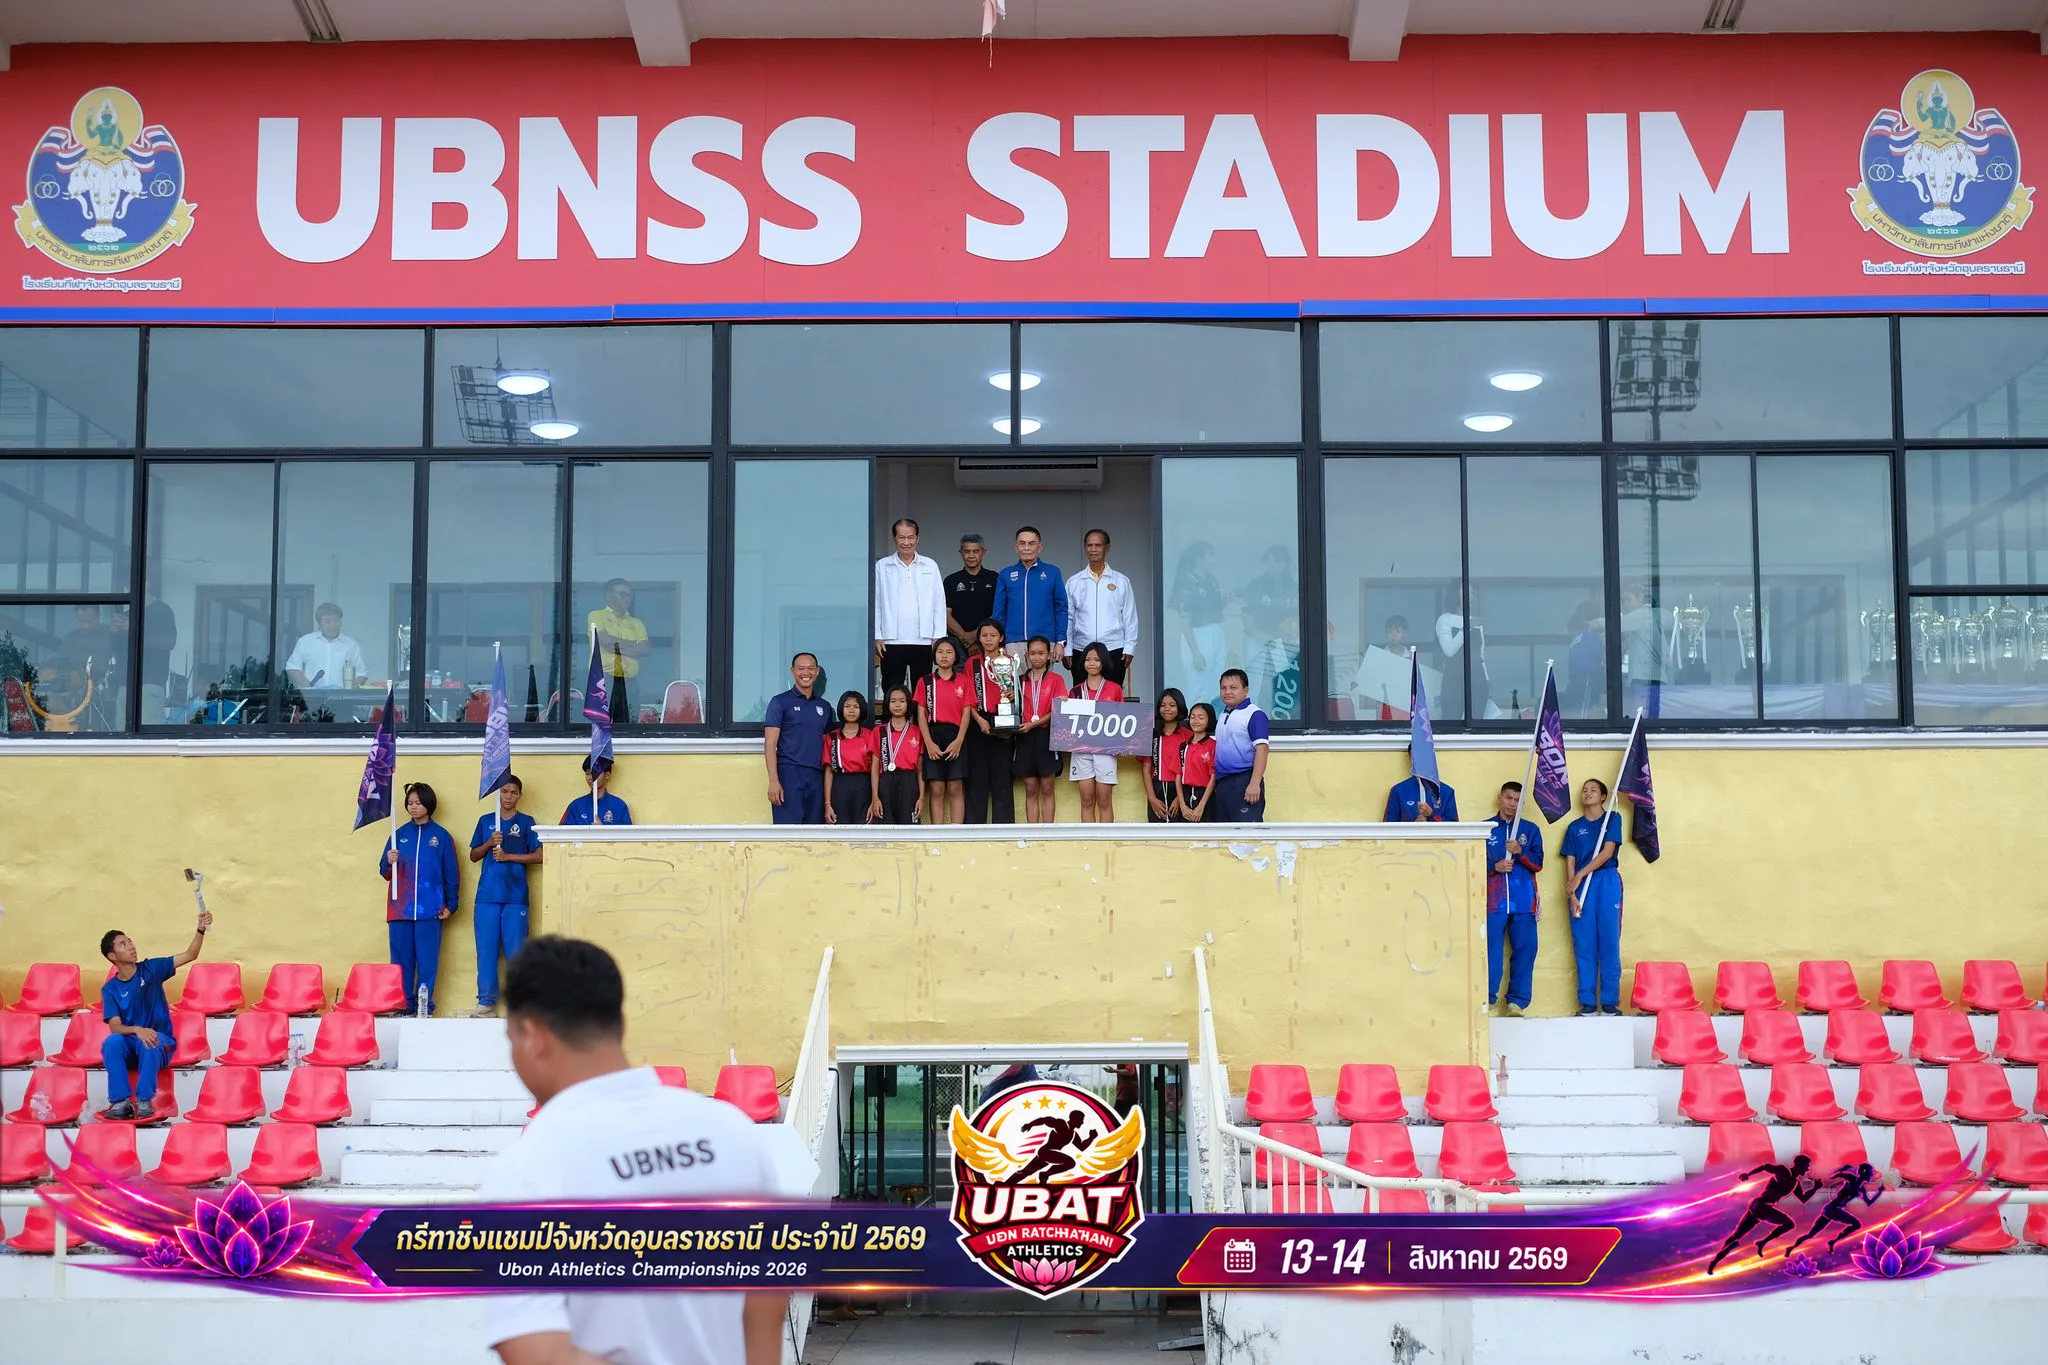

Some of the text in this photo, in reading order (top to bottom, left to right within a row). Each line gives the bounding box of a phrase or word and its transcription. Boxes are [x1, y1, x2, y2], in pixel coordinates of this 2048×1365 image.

[256, 110, 1790, 265] UBNSS STADIUM
[35, 229, 173, 267] มหาวิทยาลัยการกีฬาแห่งชาติ
[1872, 212, 2013, 251] มหาวิทยาลัยการกีฬาแห่งชาติ
[23, 277, 181, 292] โรงเรียนกีฬาจังหวัดอุบลราชธานี
[1864, 261, 2025, 276] โรงเรียนกีฬาจังหวัดอุบลราชธานี
[1068, 713, 1138, 738] 1,000
[1540, 725, 1568, 785] BON
[610, 1139, 715, 1180] UBNSS
